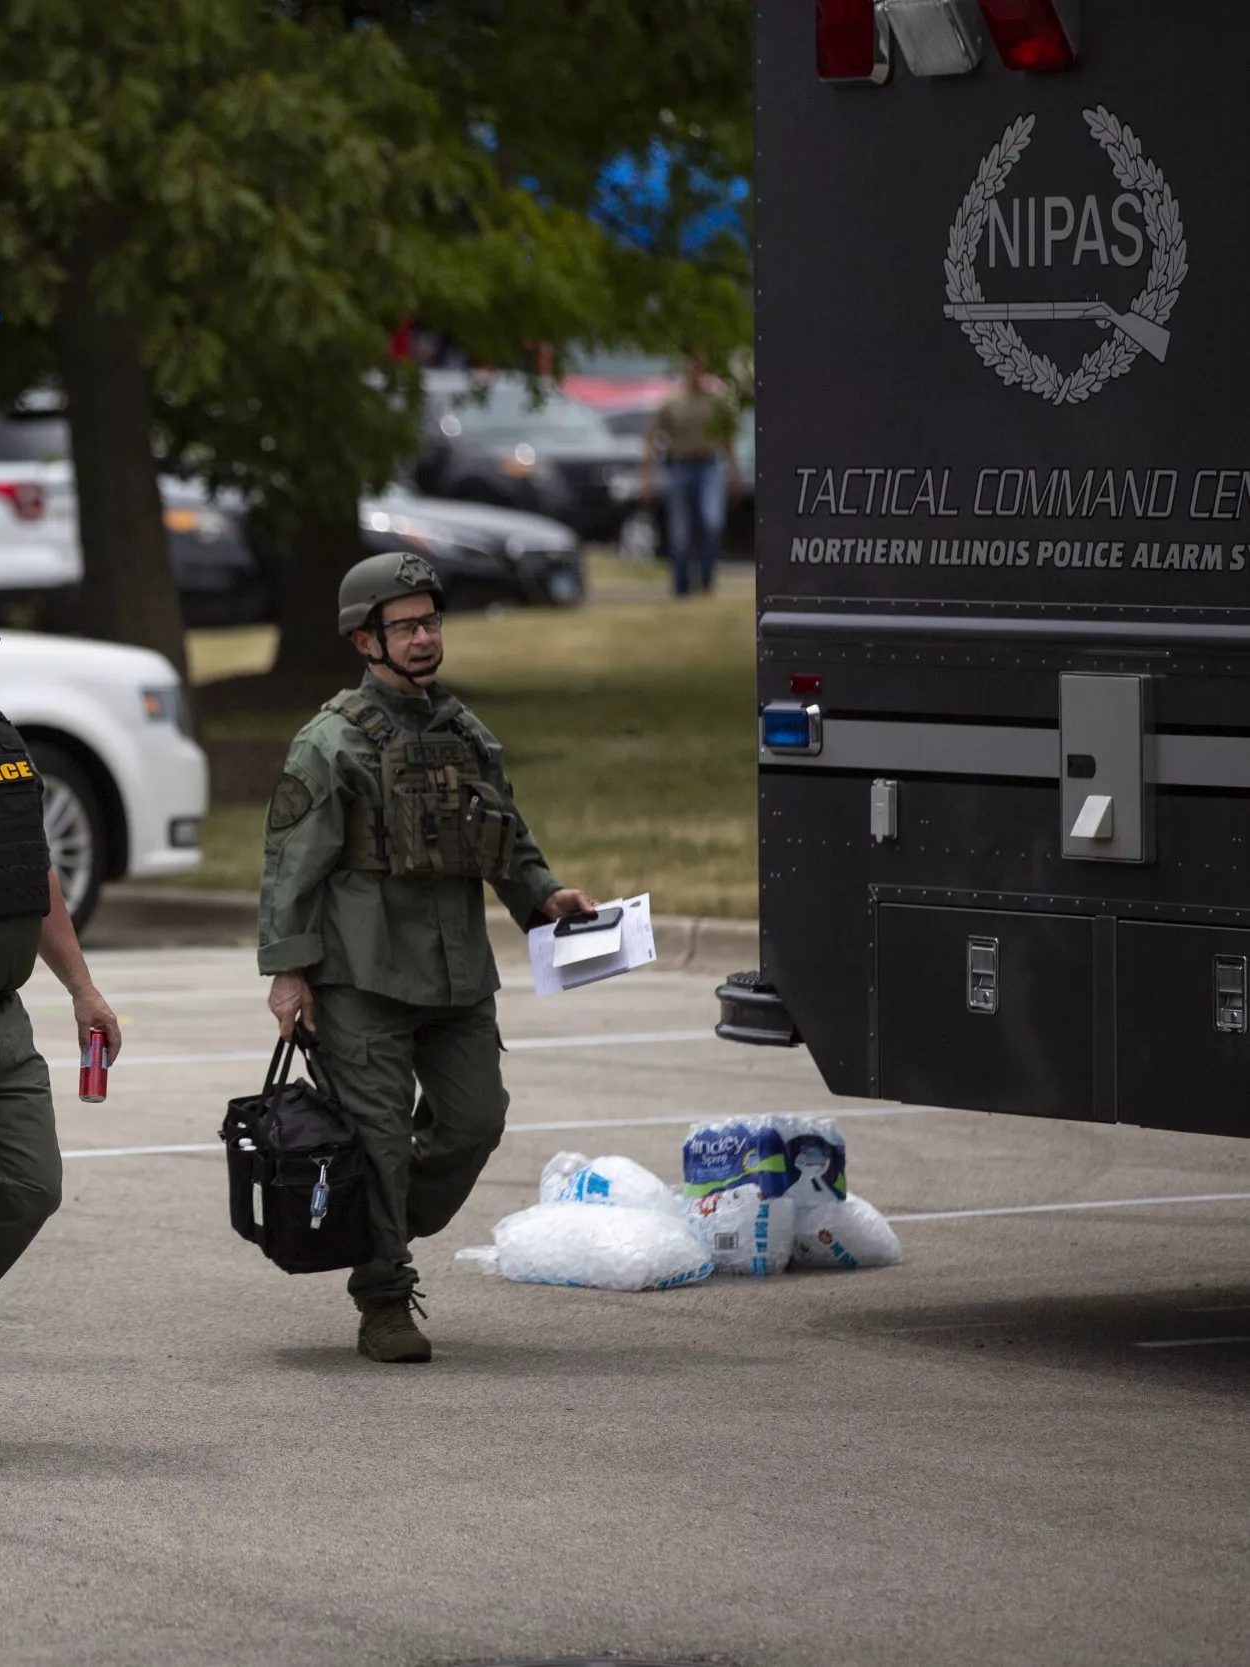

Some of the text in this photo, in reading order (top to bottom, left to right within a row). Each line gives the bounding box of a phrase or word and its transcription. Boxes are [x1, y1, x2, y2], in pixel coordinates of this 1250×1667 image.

[988, 193, 1144, 268] NIPAS
[796, 468, 958, 516] TACTICAL
[973, 469, 1178, 518] COMMAND
[790, 537, 1250, 571] NORTHERN ILLINOIS POLICE ALARM S
[414, 746, 460, 761] POLICE
